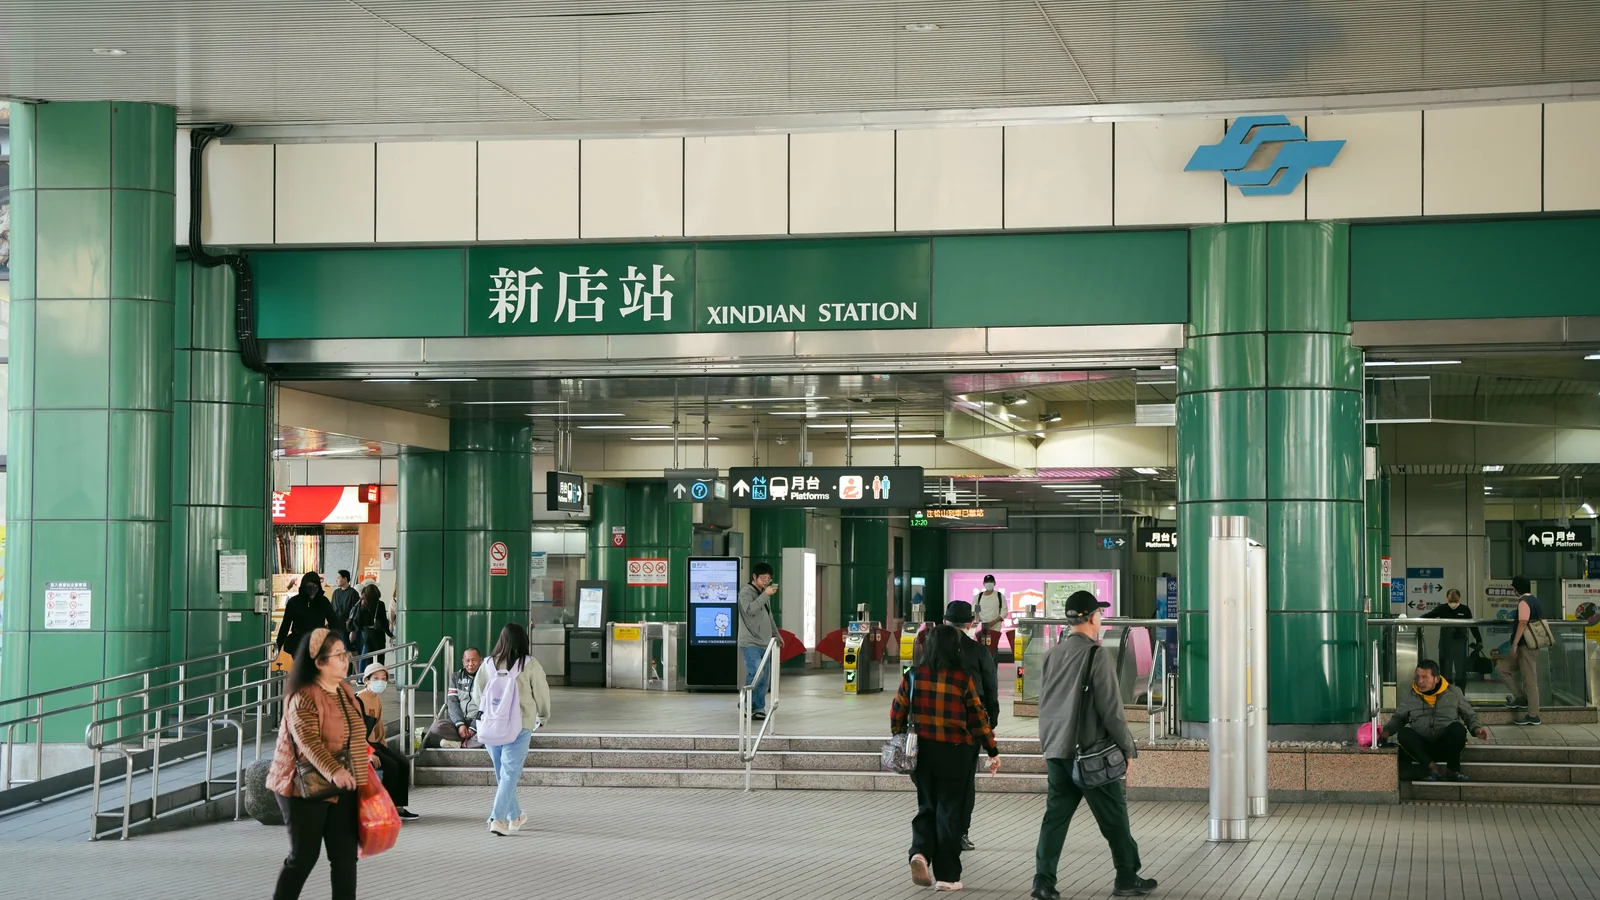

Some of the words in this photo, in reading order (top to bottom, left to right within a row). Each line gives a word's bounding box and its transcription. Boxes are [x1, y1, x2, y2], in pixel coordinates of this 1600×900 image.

[488, 264, 675, 323] 新店站
[707, 304, 806, 325] XINDIAN
[818, 302, 917, 323] STATION
[791, 475, 820, 490] 月台
[790, 492, 830, 500] Platforms
[1152, 532, 1170, 541] 月台
[1556, 531, 1576, 541] 月台
